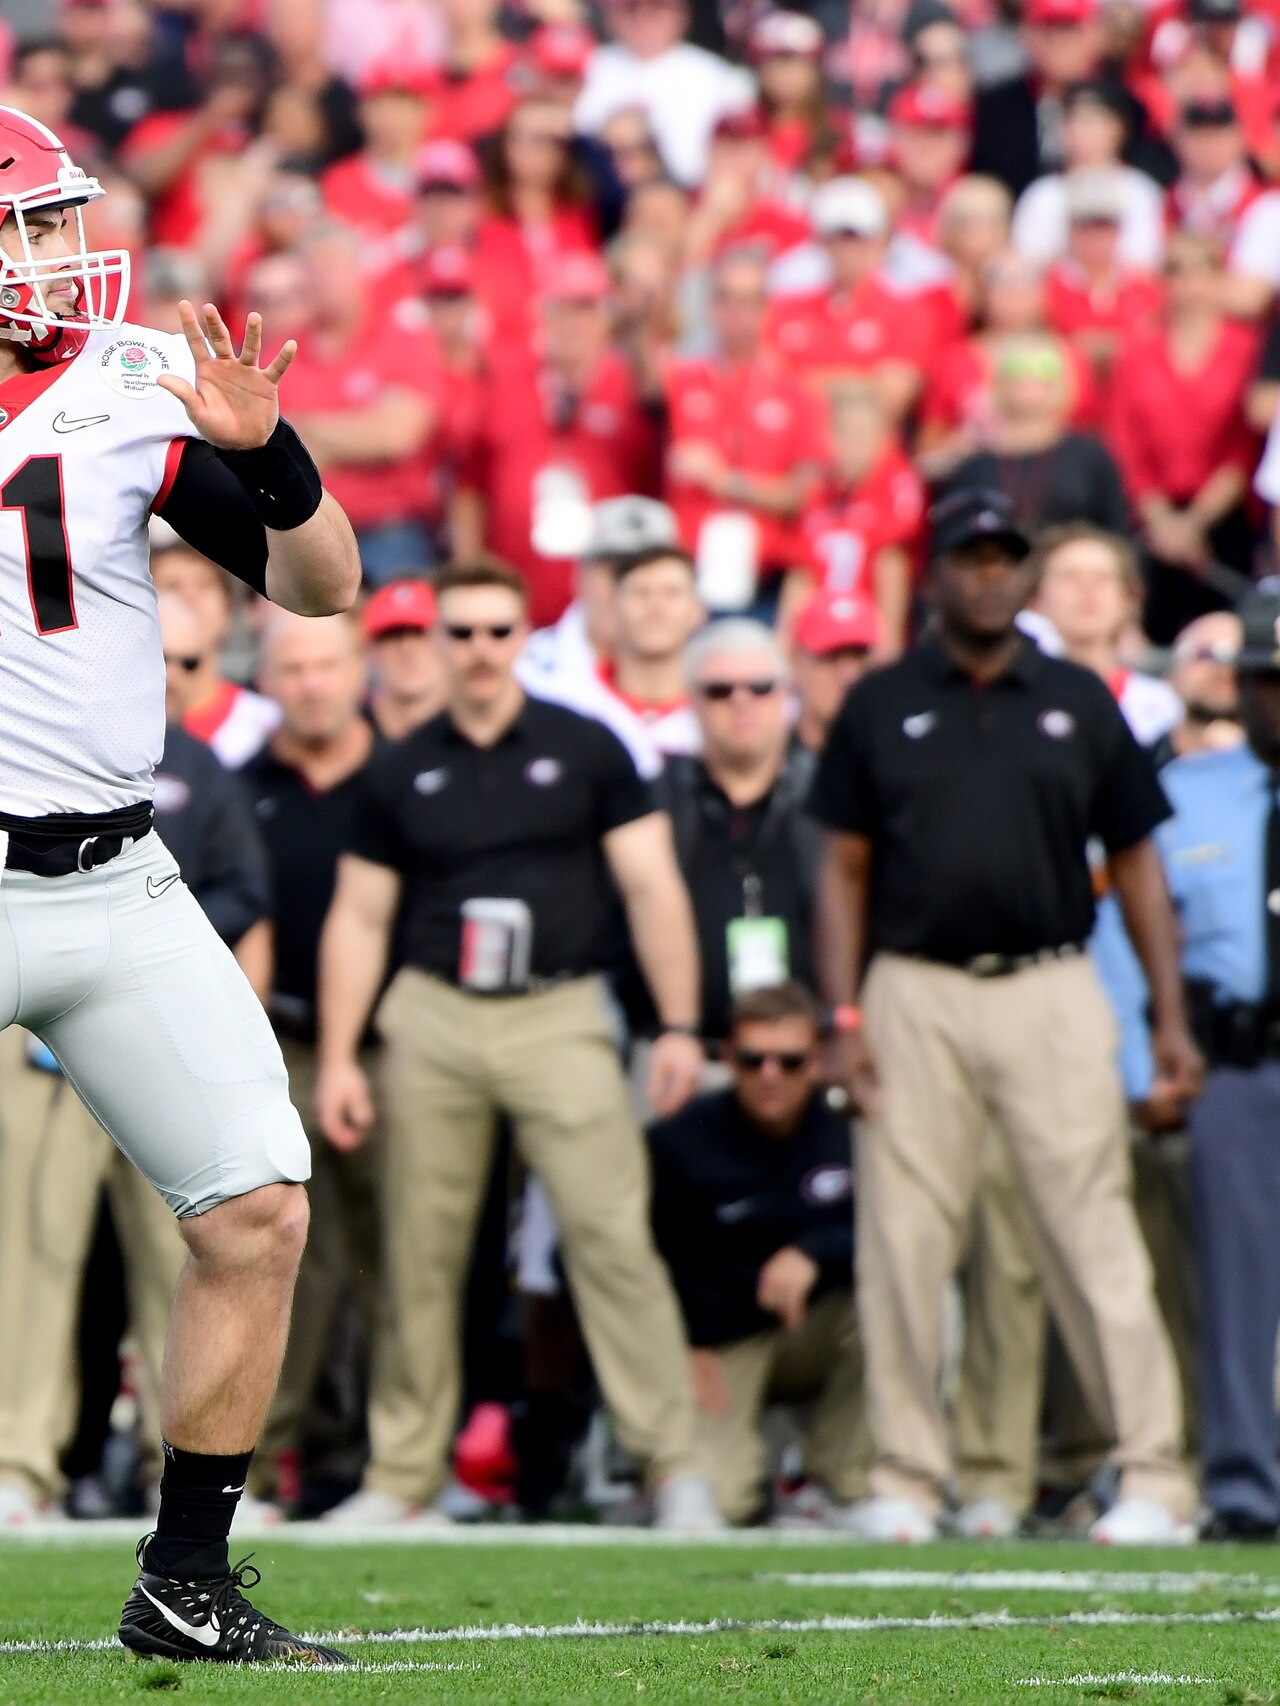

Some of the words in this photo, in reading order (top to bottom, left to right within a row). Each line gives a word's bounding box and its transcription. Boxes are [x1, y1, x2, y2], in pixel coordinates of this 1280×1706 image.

[101, 345, 118, 367] ROSE
[116, 340, 148, 349] BOWL
[150, 346, 170, 370] GAME
